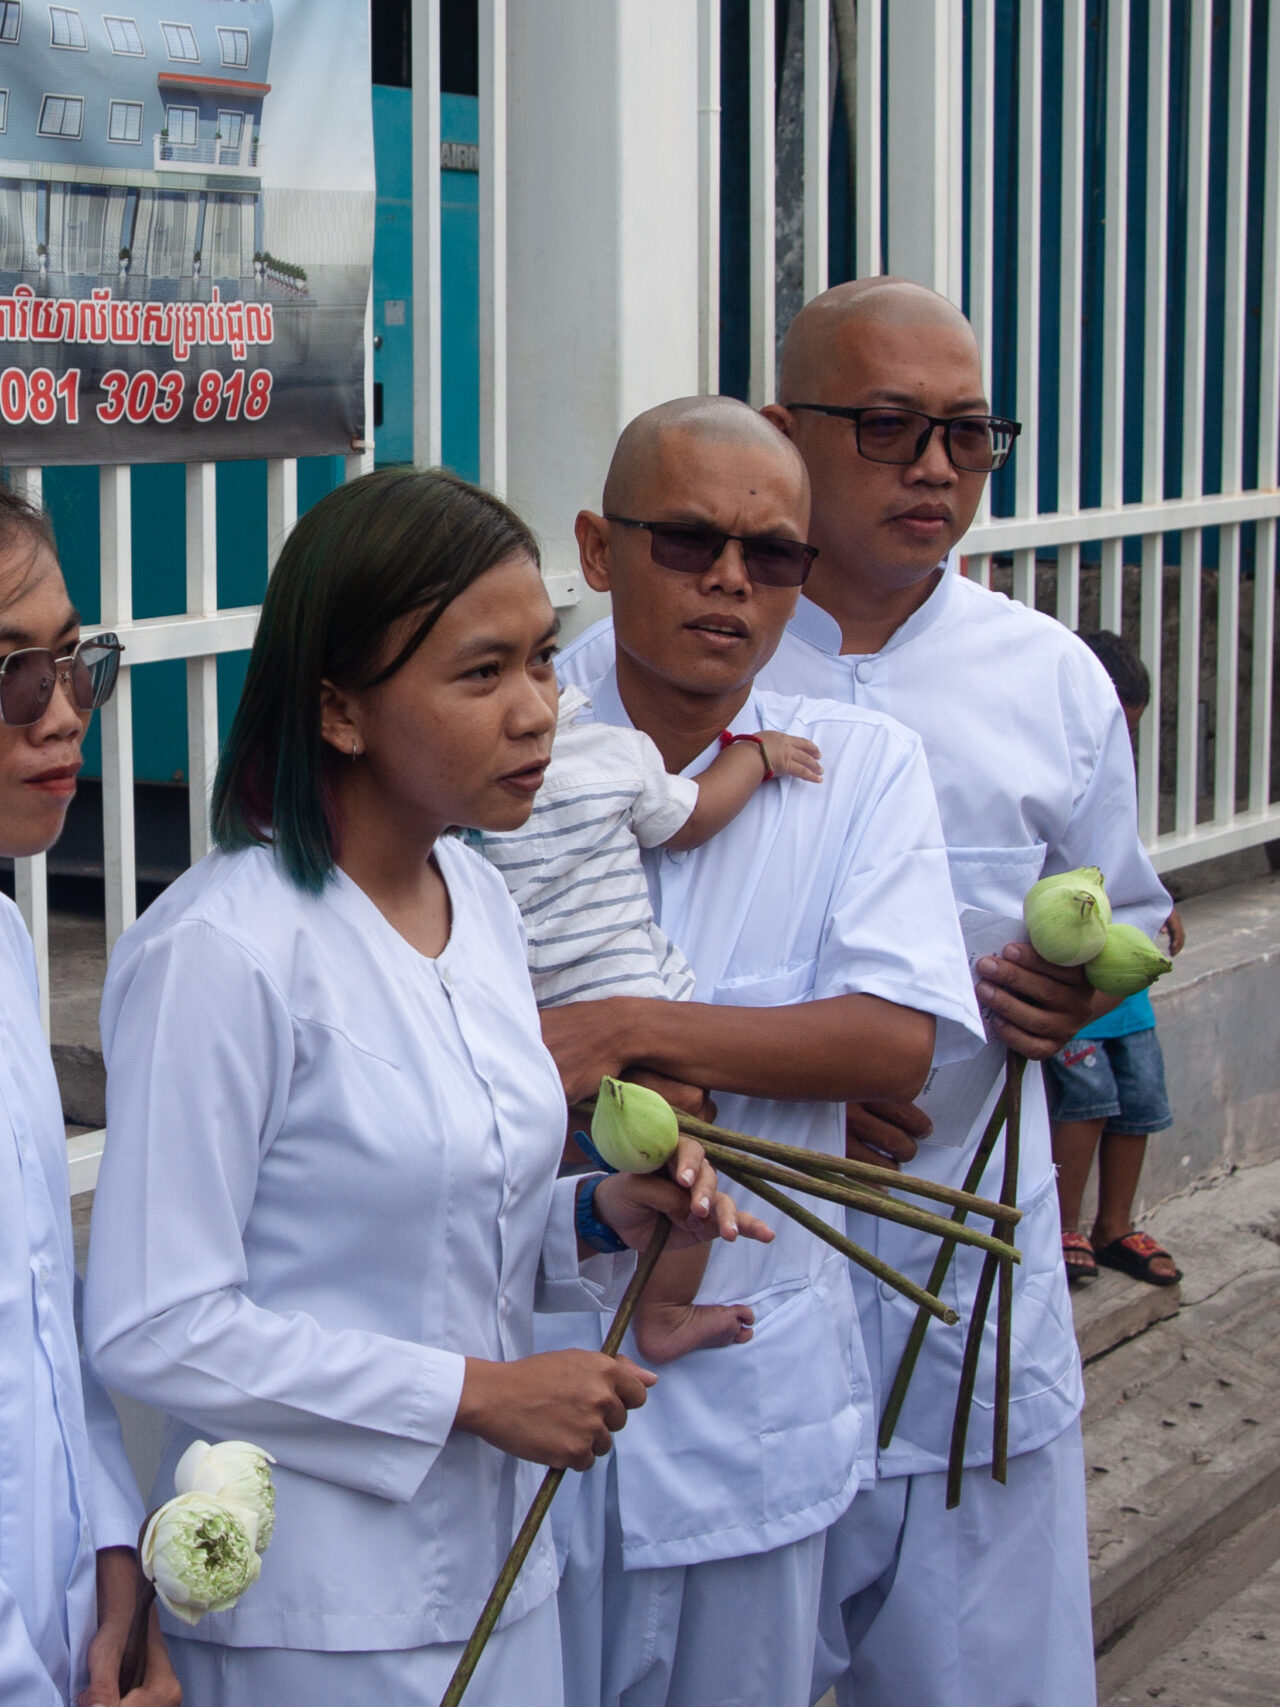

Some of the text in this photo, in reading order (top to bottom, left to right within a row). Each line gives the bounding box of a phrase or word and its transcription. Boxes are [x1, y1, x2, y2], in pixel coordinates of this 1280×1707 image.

[0, 368, 273, 424] 081 303 818
